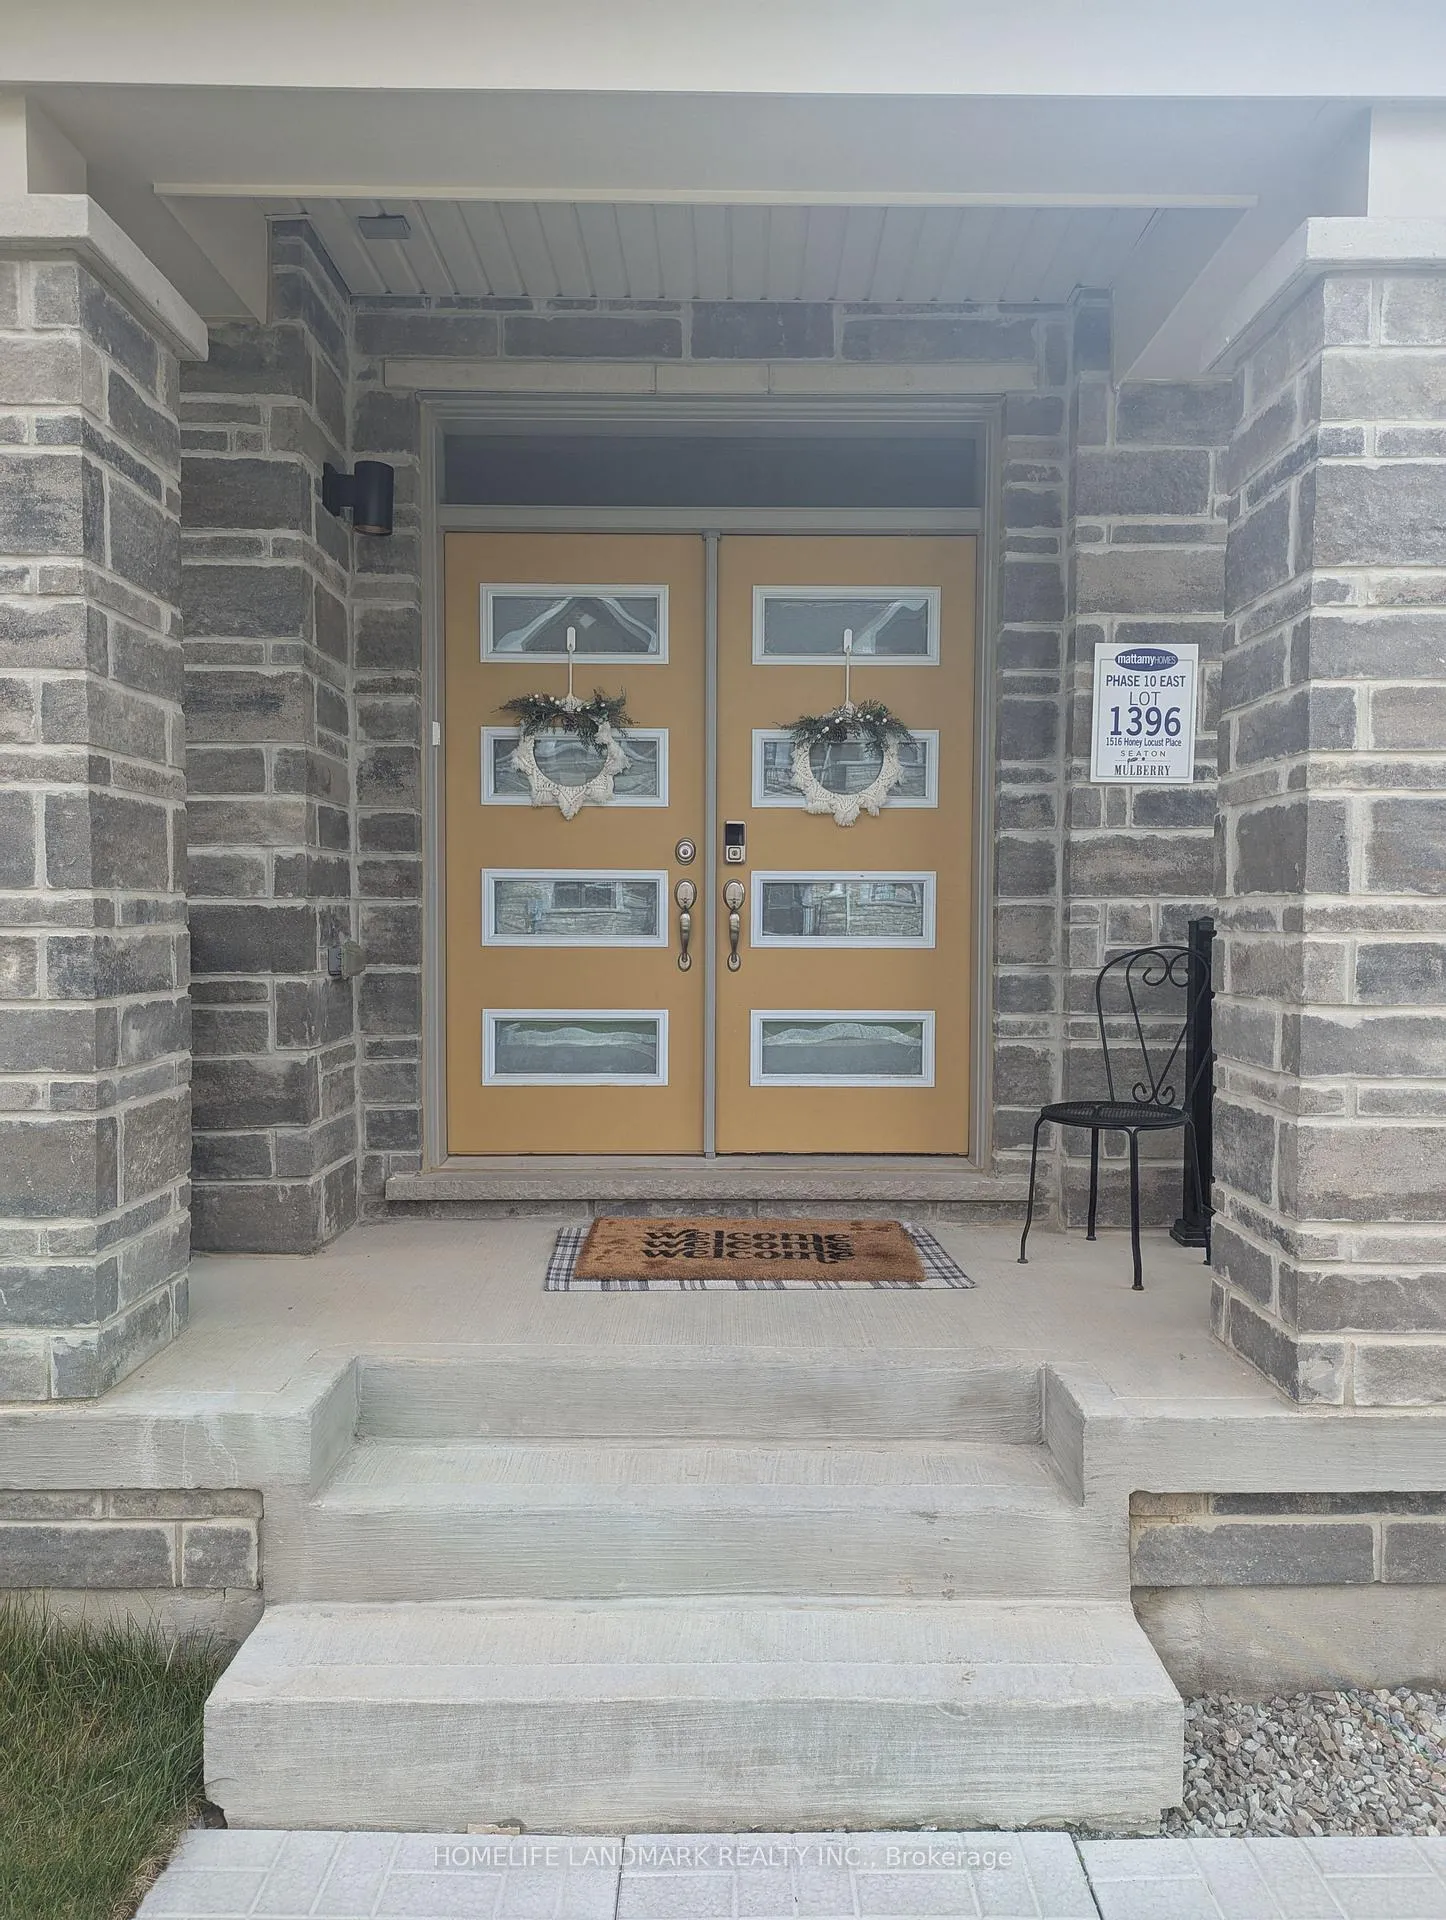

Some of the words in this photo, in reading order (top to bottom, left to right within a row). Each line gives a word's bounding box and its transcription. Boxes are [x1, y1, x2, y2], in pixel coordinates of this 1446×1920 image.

[1106, 675, 1140, 686] PHASE
[1145, 676, 1156, 686] 10
[1160, 676, 1186, 687] EAST
[1130, 692, 1160, 705] LOT
[1110, 706, 1181, 736] 1396
[1106, 737, 1122, 746] 1516
[1124, 738, 1142, 748] Honey
[1144, 738, 1163, 746] Locust
[1165, 738, 1181, 746] Place
[1114, 765, 1171, 775] MULBERRY
[641, 1247, 855, 1264] welcome
